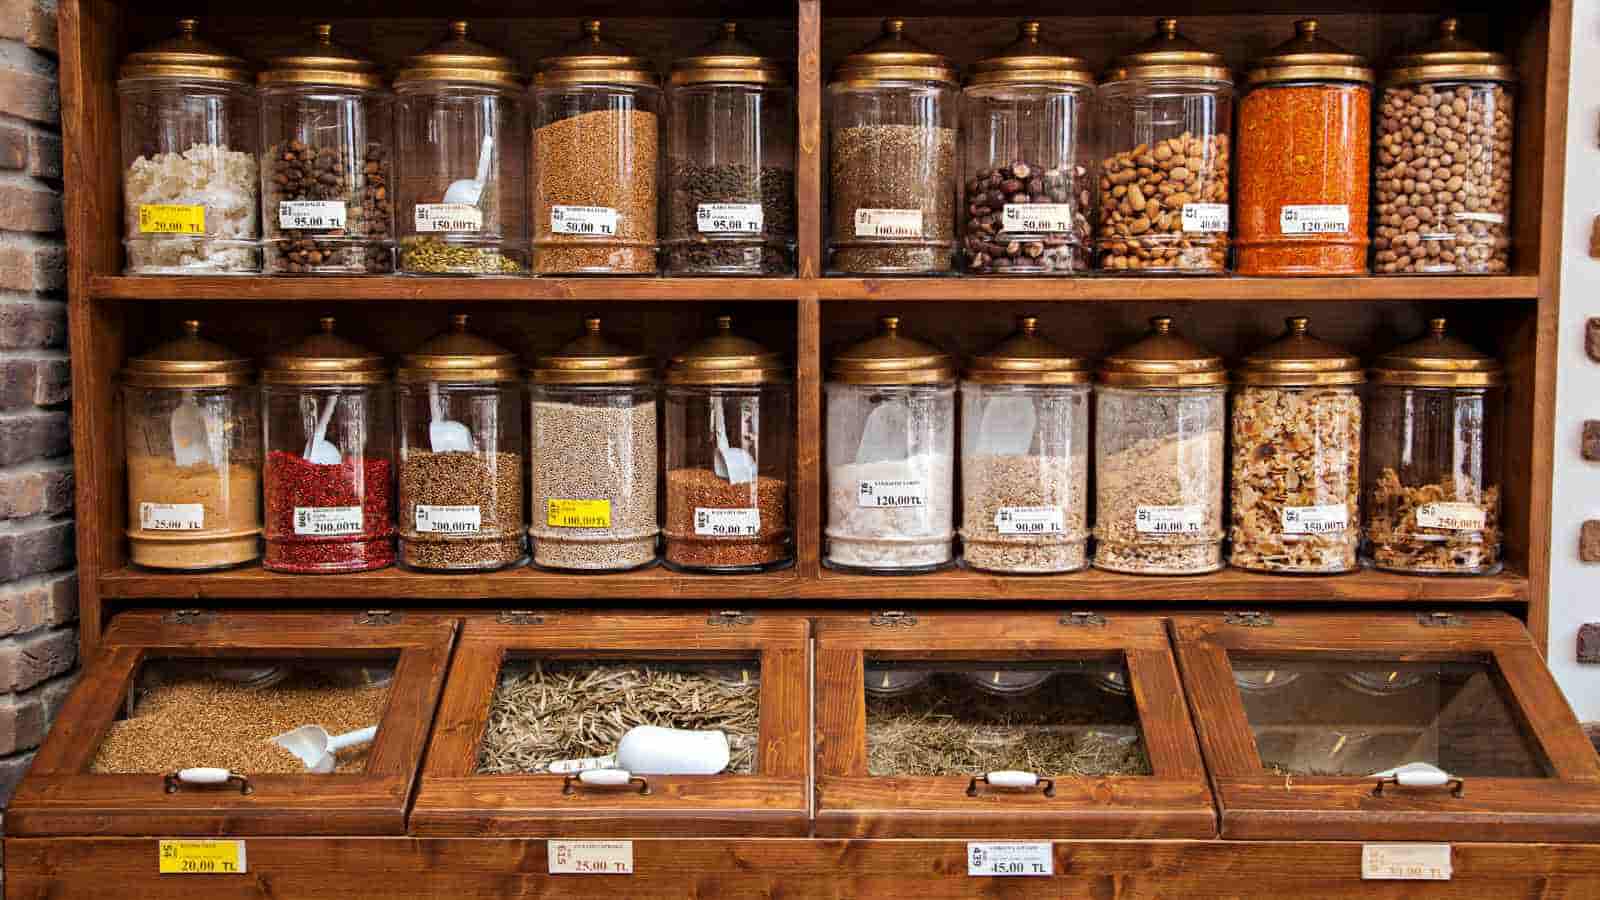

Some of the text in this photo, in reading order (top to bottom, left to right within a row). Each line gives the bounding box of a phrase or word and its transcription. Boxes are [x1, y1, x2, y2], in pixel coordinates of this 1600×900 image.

[294, 217, 322, 227] 95,00
[713, 220, 742, 230] 95,00
[1024, 221, 1050, 231] 50,00
[1302, 222, 1345, 231] 120,00TL
[190, 224, 202, 232] TL
[566, 223, 612, 233] 50,00 TL
[877, 495, 921, 506] 120,00TL
[314, 521, 360, 533] 200,00TL
[432, 522, 477, 531] 200,00TL
[713, 525, 755, 534] 50,00 TL
[1016, 523, 1044, 532] 90,00
[1154, 522, 1182, 531] 40,00
[973, 847, 981, 866] 439
[182, 860, 236, 871] 20,00 TL
[576, 860, 628, 871] 25,00 TL
[1032, 864, 1046, 872] TL
